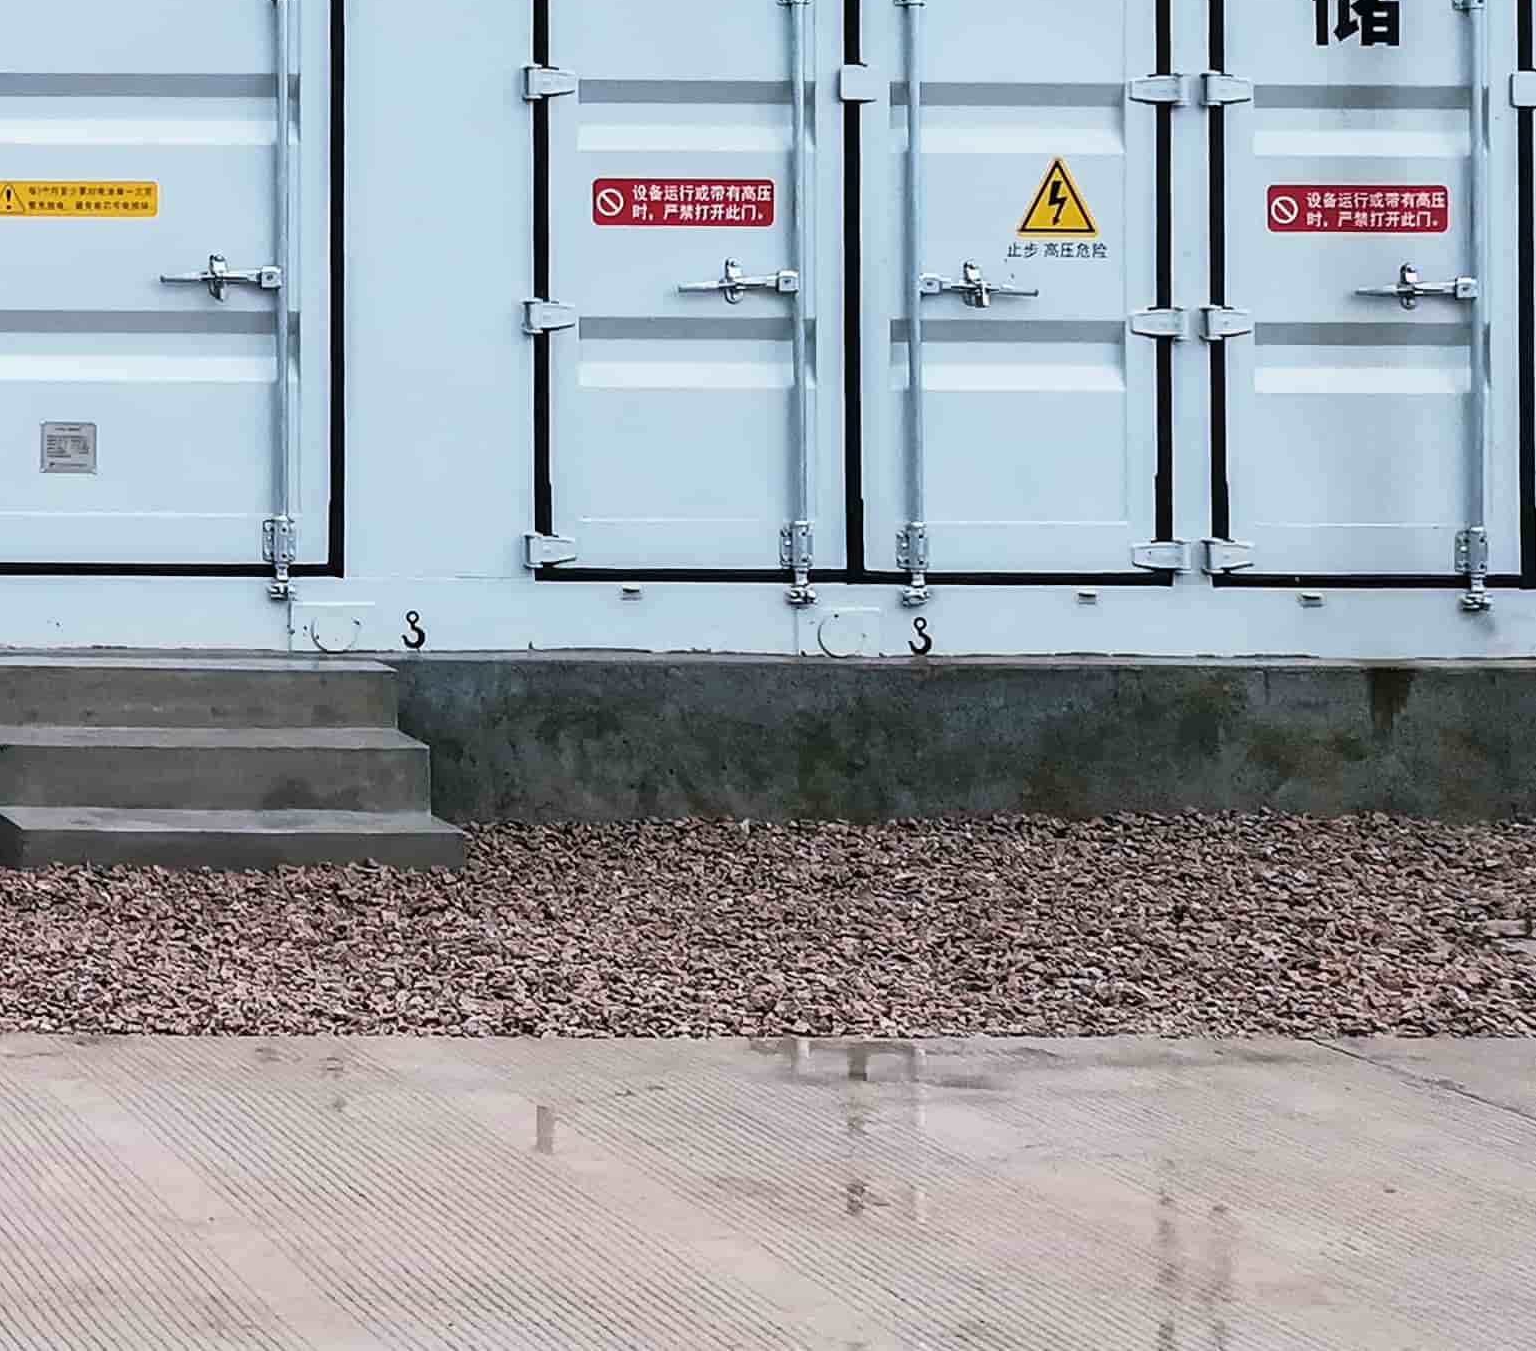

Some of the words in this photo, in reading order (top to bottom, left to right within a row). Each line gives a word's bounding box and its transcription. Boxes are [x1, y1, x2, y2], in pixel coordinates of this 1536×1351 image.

[1007, 242, 1038, 258] 止步
[1044, 242, 1107, 258] 高压危险
